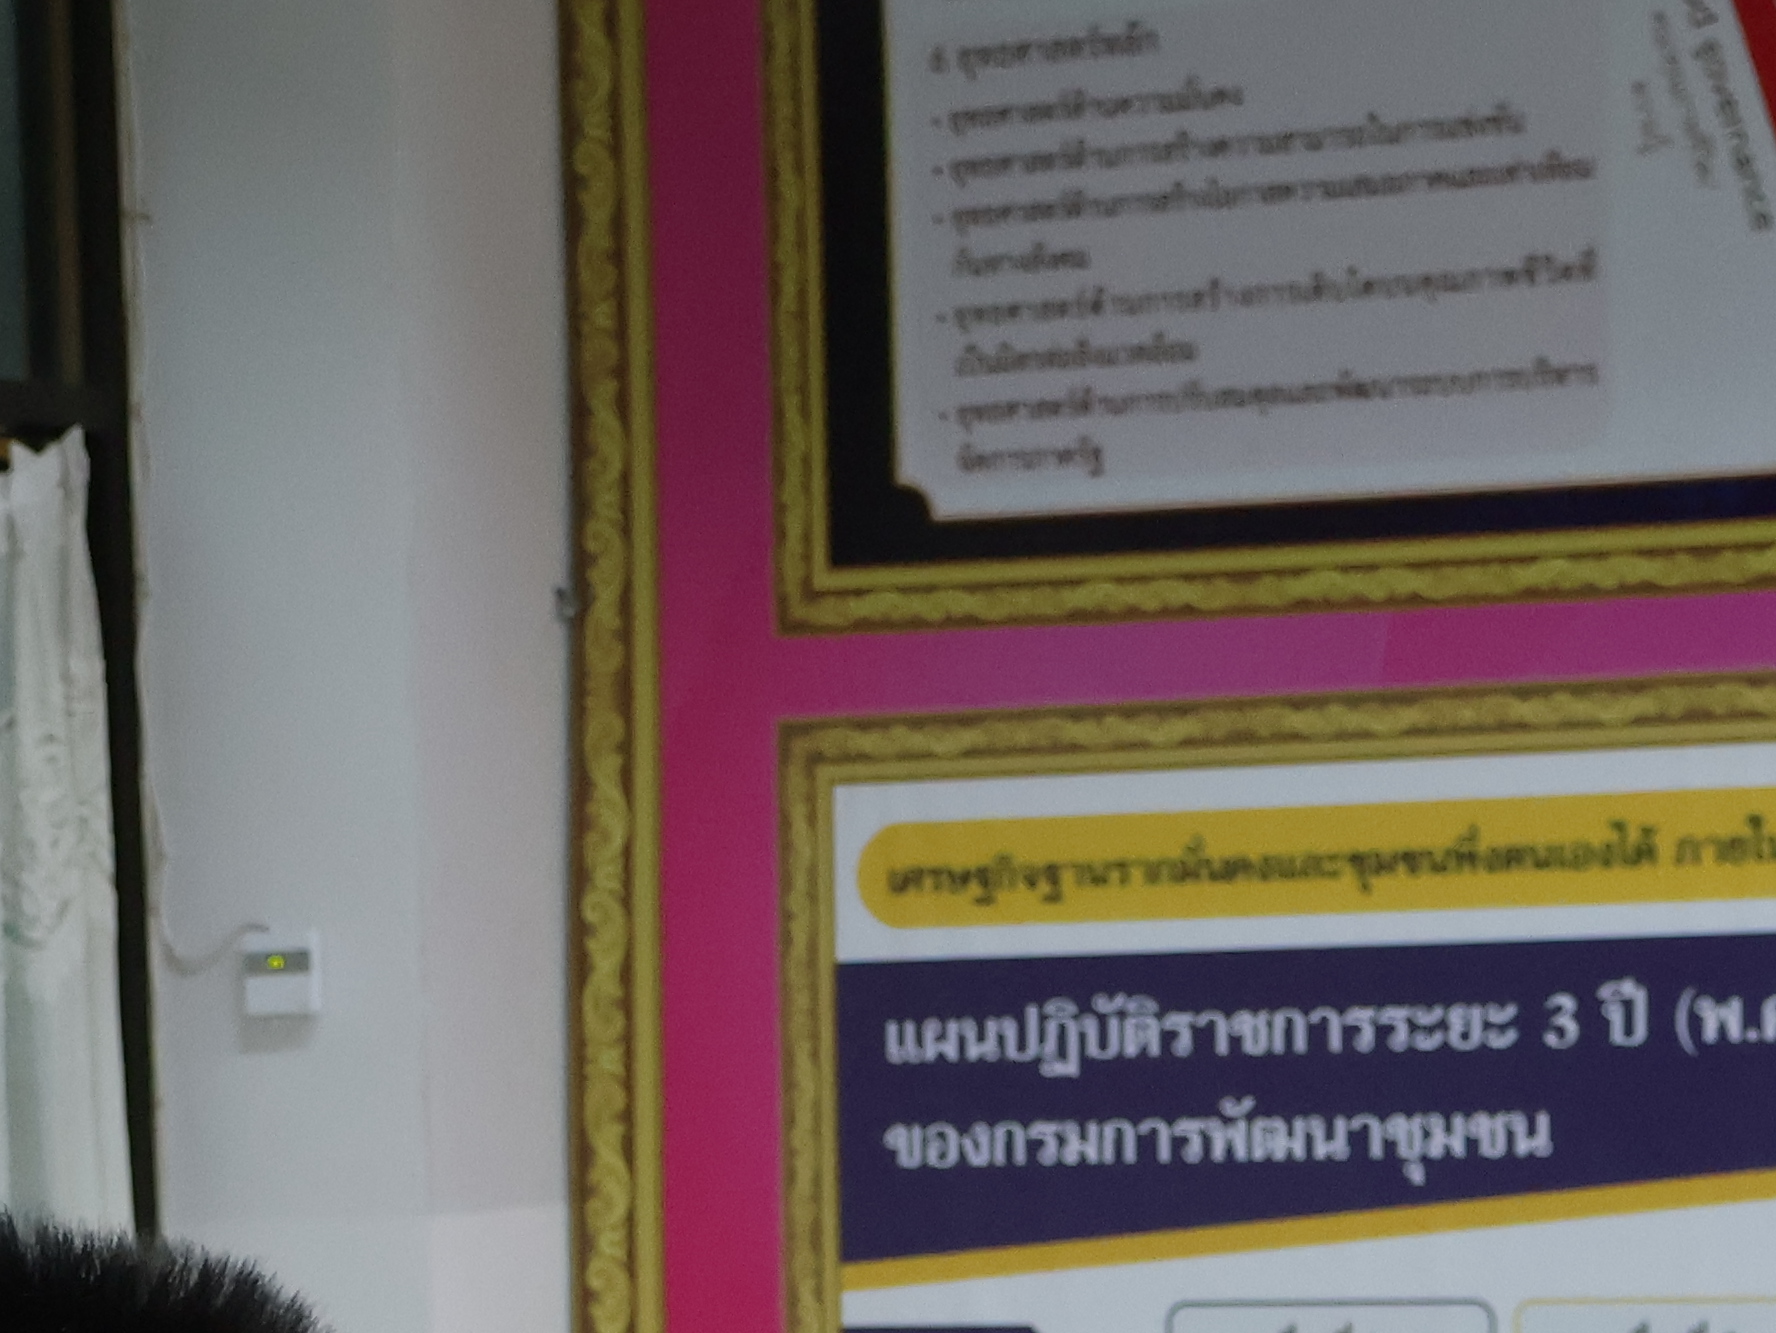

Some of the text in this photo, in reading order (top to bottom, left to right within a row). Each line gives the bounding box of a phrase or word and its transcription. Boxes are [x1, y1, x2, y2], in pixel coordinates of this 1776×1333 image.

[885, 992, 1517, 1079] แผนปฏิบัติราชการระยะ
[1543, 993, 1580, 1051] 3
[1600, 975, 1648, 1049] ปี
[883, 1097, 1553, 1186] ของกรมการพัฒนาชุมชน
